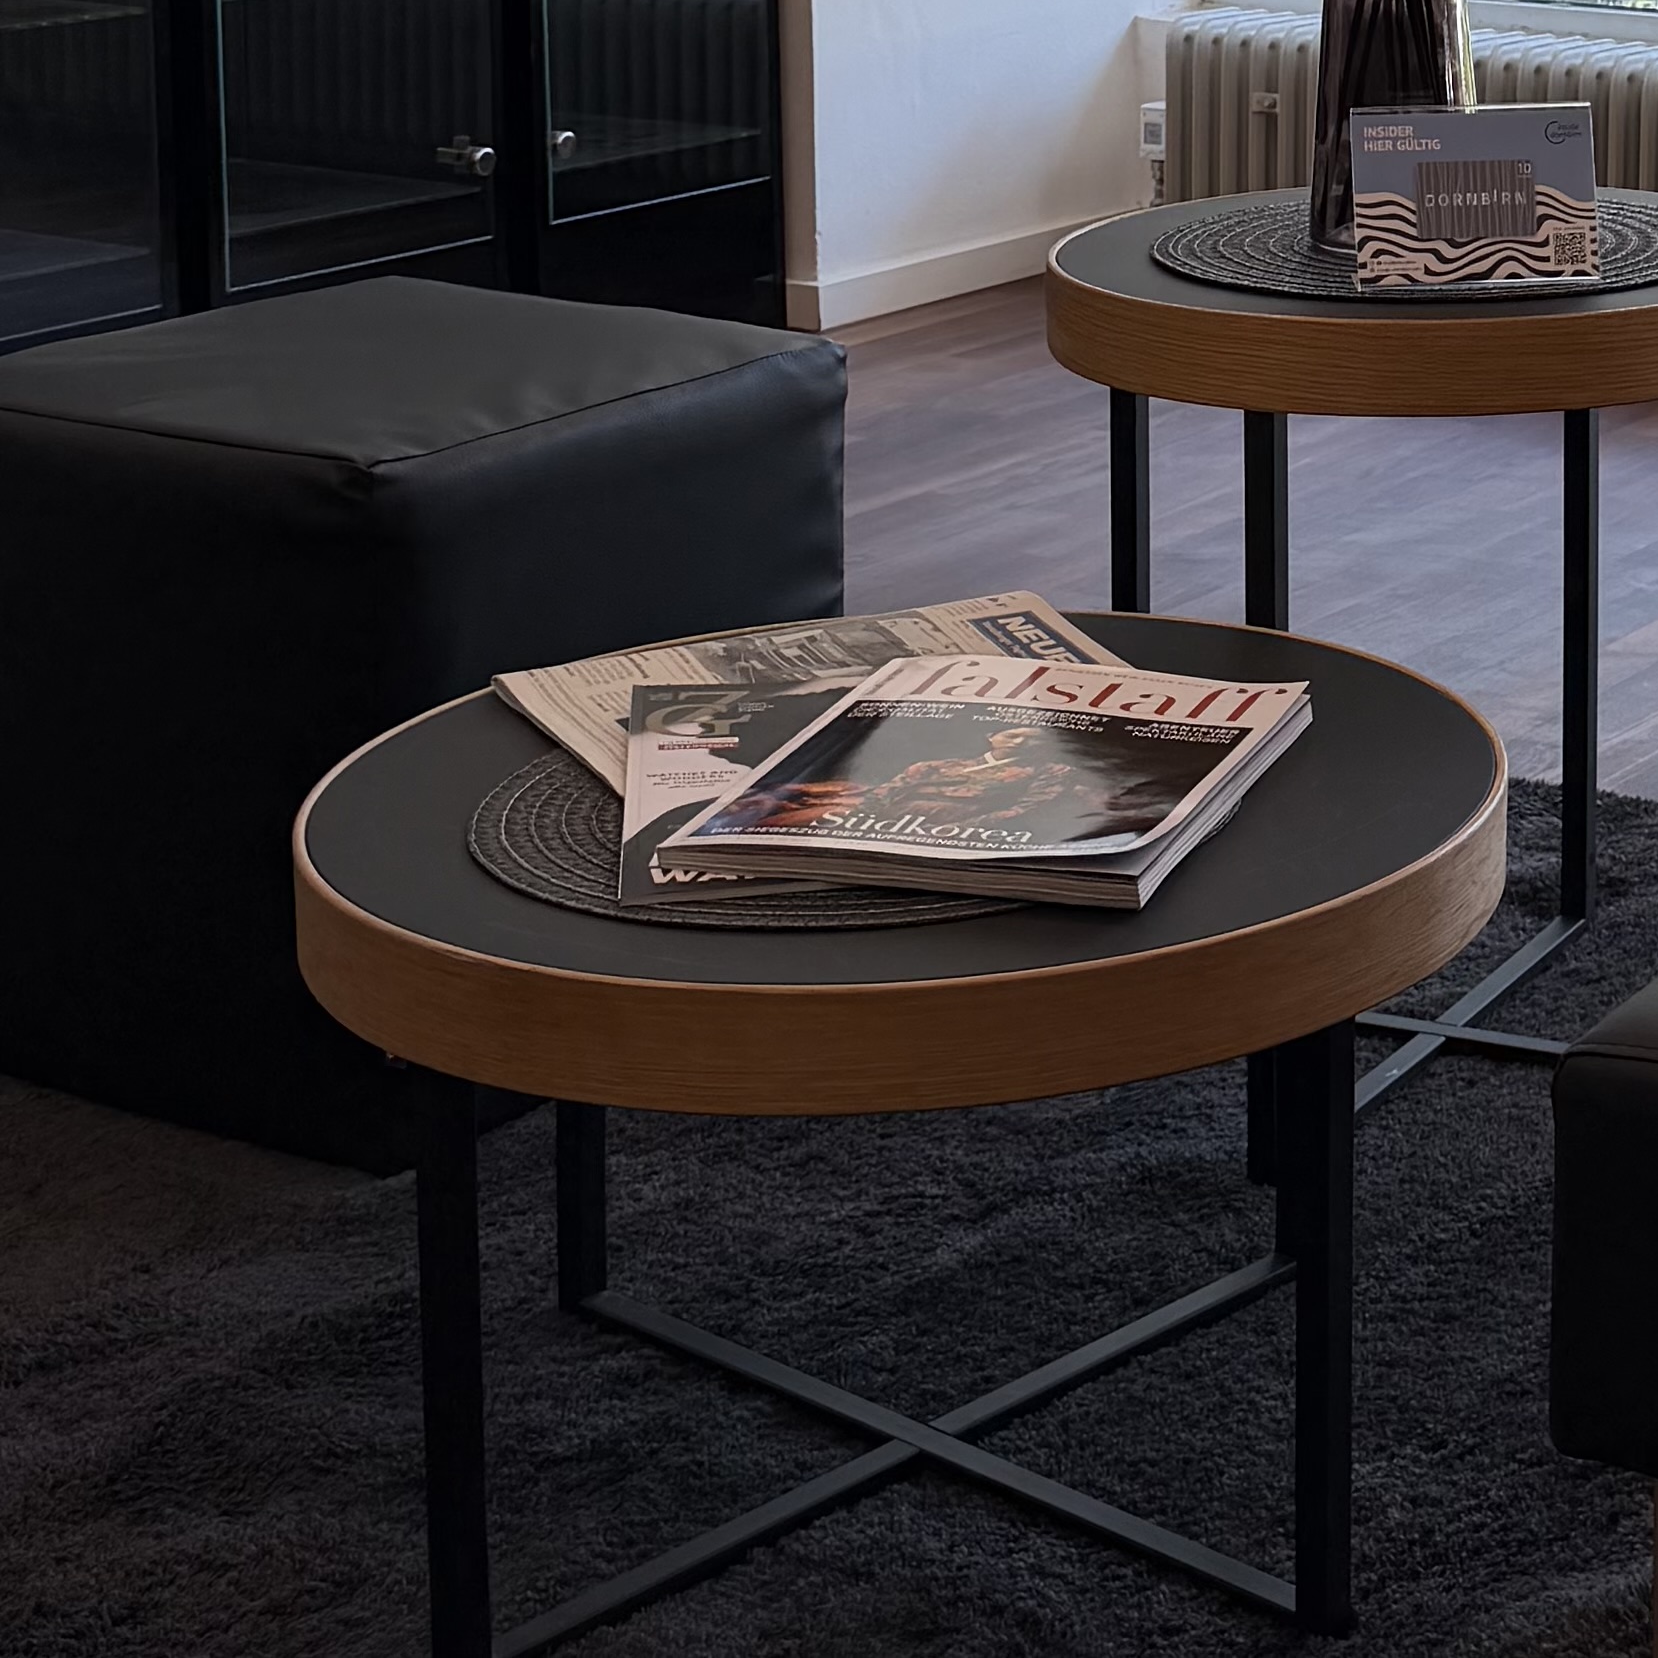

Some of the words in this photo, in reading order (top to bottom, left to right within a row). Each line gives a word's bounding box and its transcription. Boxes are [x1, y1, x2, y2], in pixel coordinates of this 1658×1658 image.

[1364, 125, 1413, 138] INSIDER
[1364, 139, 1393, 151] HIER
[1397, 137, 1441, 150] GÜLTIG
[1425, 188, 1527, 207] DORNBIRN
[910, 660, 1288, 722] falstaff
[809, 809, 1033, 843] Südkorea
